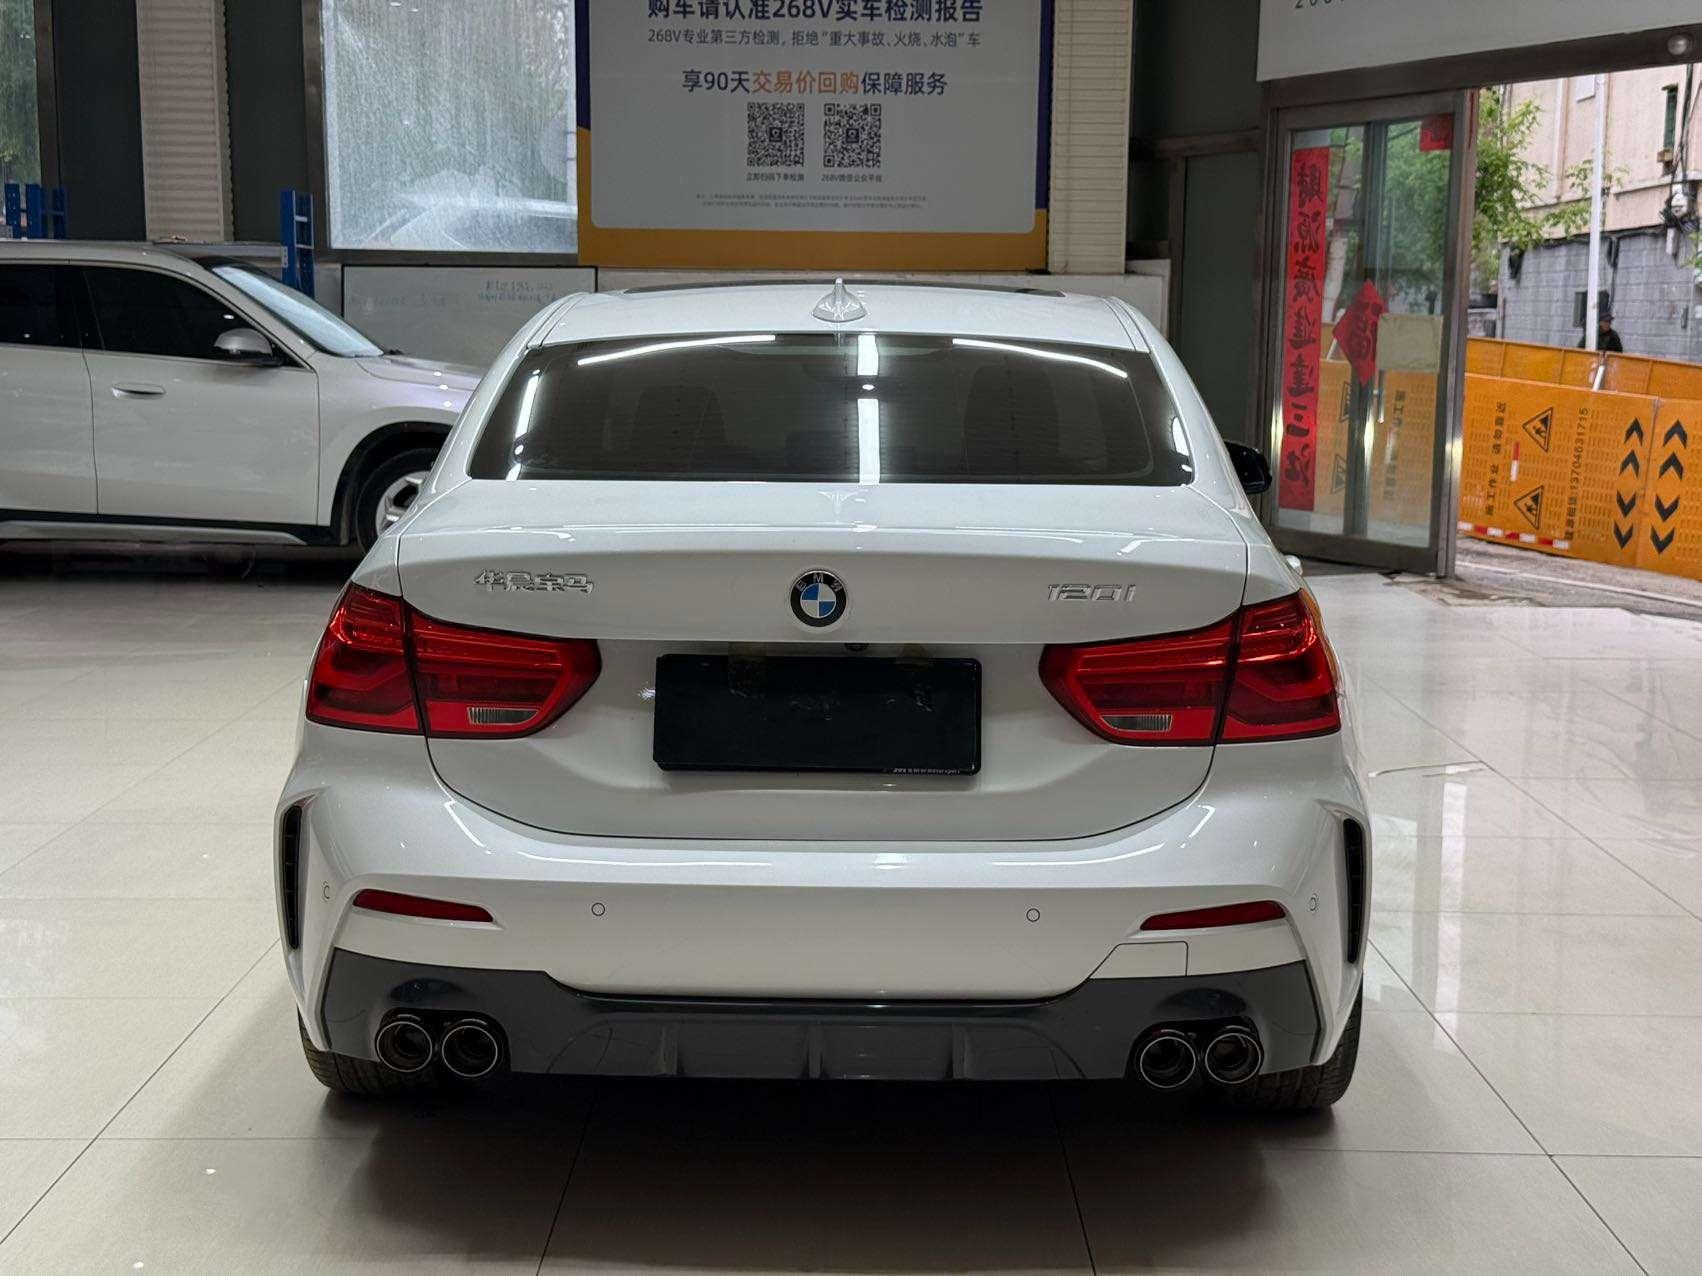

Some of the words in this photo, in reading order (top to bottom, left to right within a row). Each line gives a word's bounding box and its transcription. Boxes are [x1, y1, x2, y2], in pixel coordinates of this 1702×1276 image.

[681, 69, 948, 96] 享90天交易价回购保障服务
